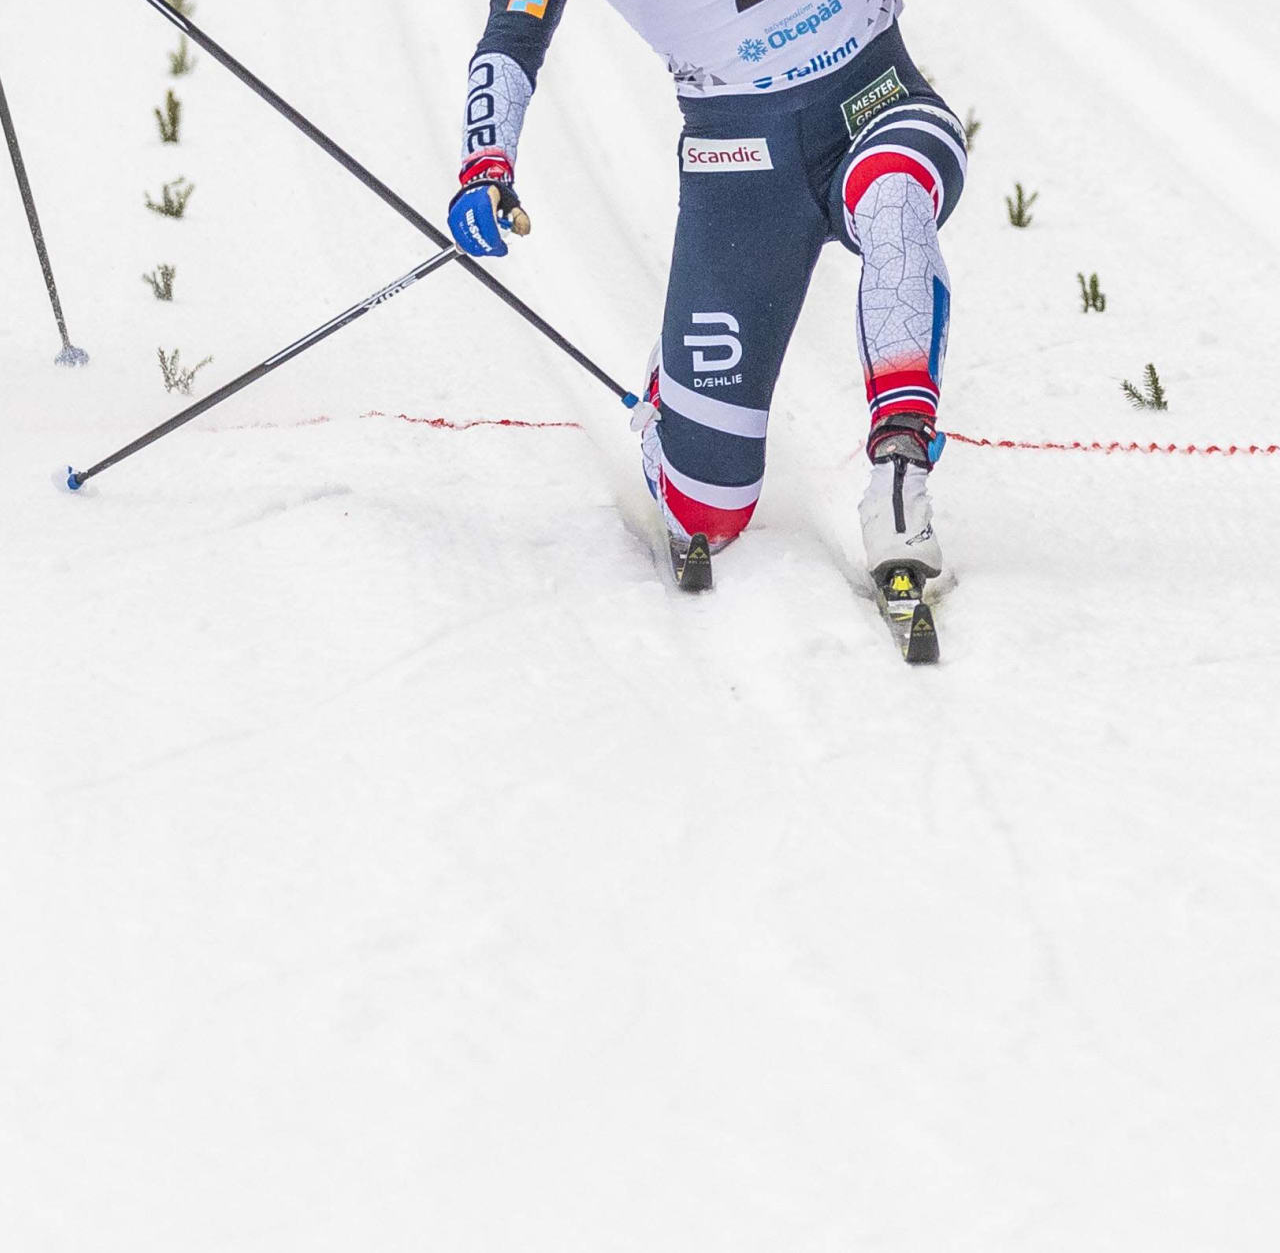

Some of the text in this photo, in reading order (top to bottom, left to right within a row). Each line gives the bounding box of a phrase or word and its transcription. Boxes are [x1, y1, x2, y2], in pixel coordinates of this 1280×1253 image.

[785, 36, 859, 82] Tallinn
[852, 78, 895, 114] MESTER
[688, 148, 762, 163] Scandic
[694, 374, 742, 388] DÆHLIE
